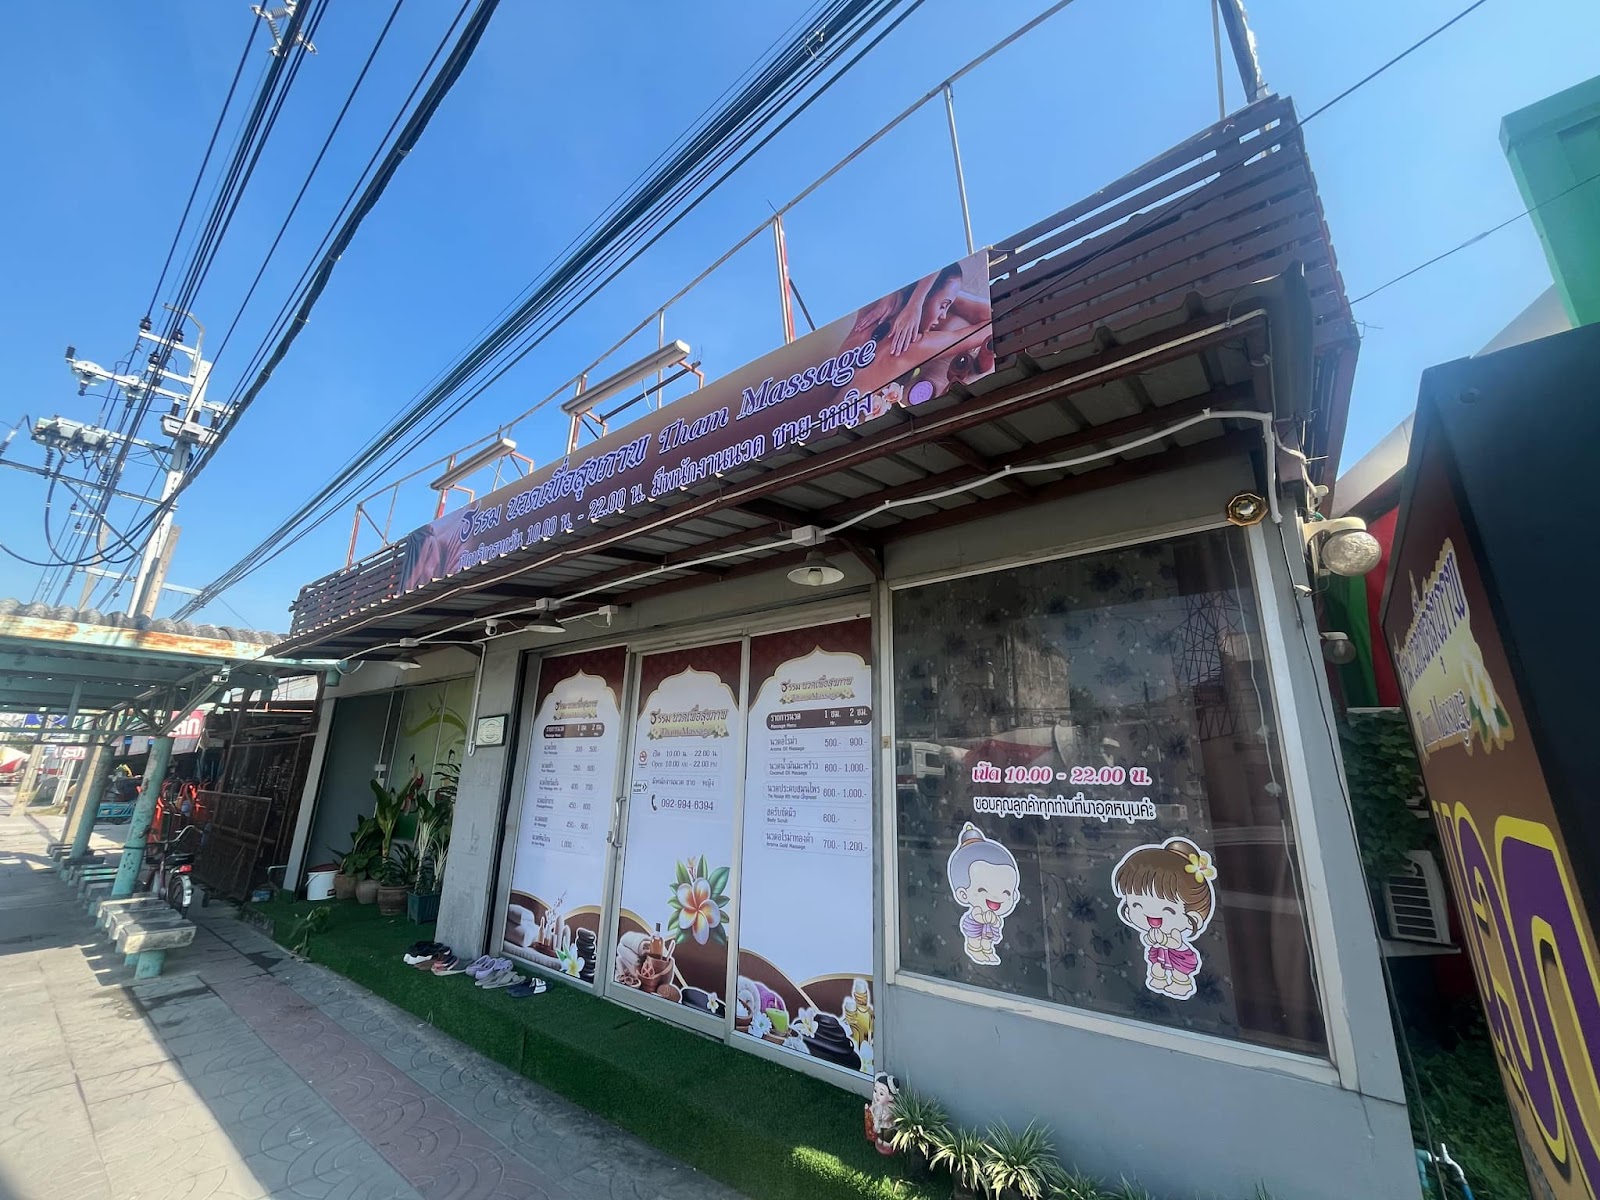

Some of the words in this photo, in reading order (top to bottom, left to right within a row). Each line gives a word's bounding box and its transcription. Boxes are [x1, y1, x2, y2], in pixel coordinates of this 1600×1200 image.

[459, 500, 502, 543] ธรรม
[506, 433, 652, 522] นวดเพื่อสุขภาพ
[658, 406, 729, 454] Tham
[736, 339, 876, 421] Massage
[458, 528, 524, 572] เปิดบริการทกวัน
[588, 487, 627, 520] 22.00
[630, 483, 646, 506] น.
[651, 433, 765, 497] มีพนักงานนวด
[650, 708, 671, 725] ธรรม
[824, 709, 828, 718] 1
[849, 708, 854, 717] 2
[824, 738, 841, 747] 500.-
[849, 737, 867, 746] 900.-
[825, 763, 842, 772] 600.-
[972, 761, 1001, 783] เปิด
[1005, 765, 1052, 784] 10.00
[1056, 772, 1067, 781] -
[1070, 766, 1126, 785] 22.00
[1130, 766, 1153, 785] น.
[823, 788, 840, 797] 600.-
[973, 793, 1157, 824] ขอบคุณลูกค้าทุกท่านที่มาอุดหนุนค่ะ
[823, 813, 840, 823] 600.-
[823, 839, 840, 849] 700.-
